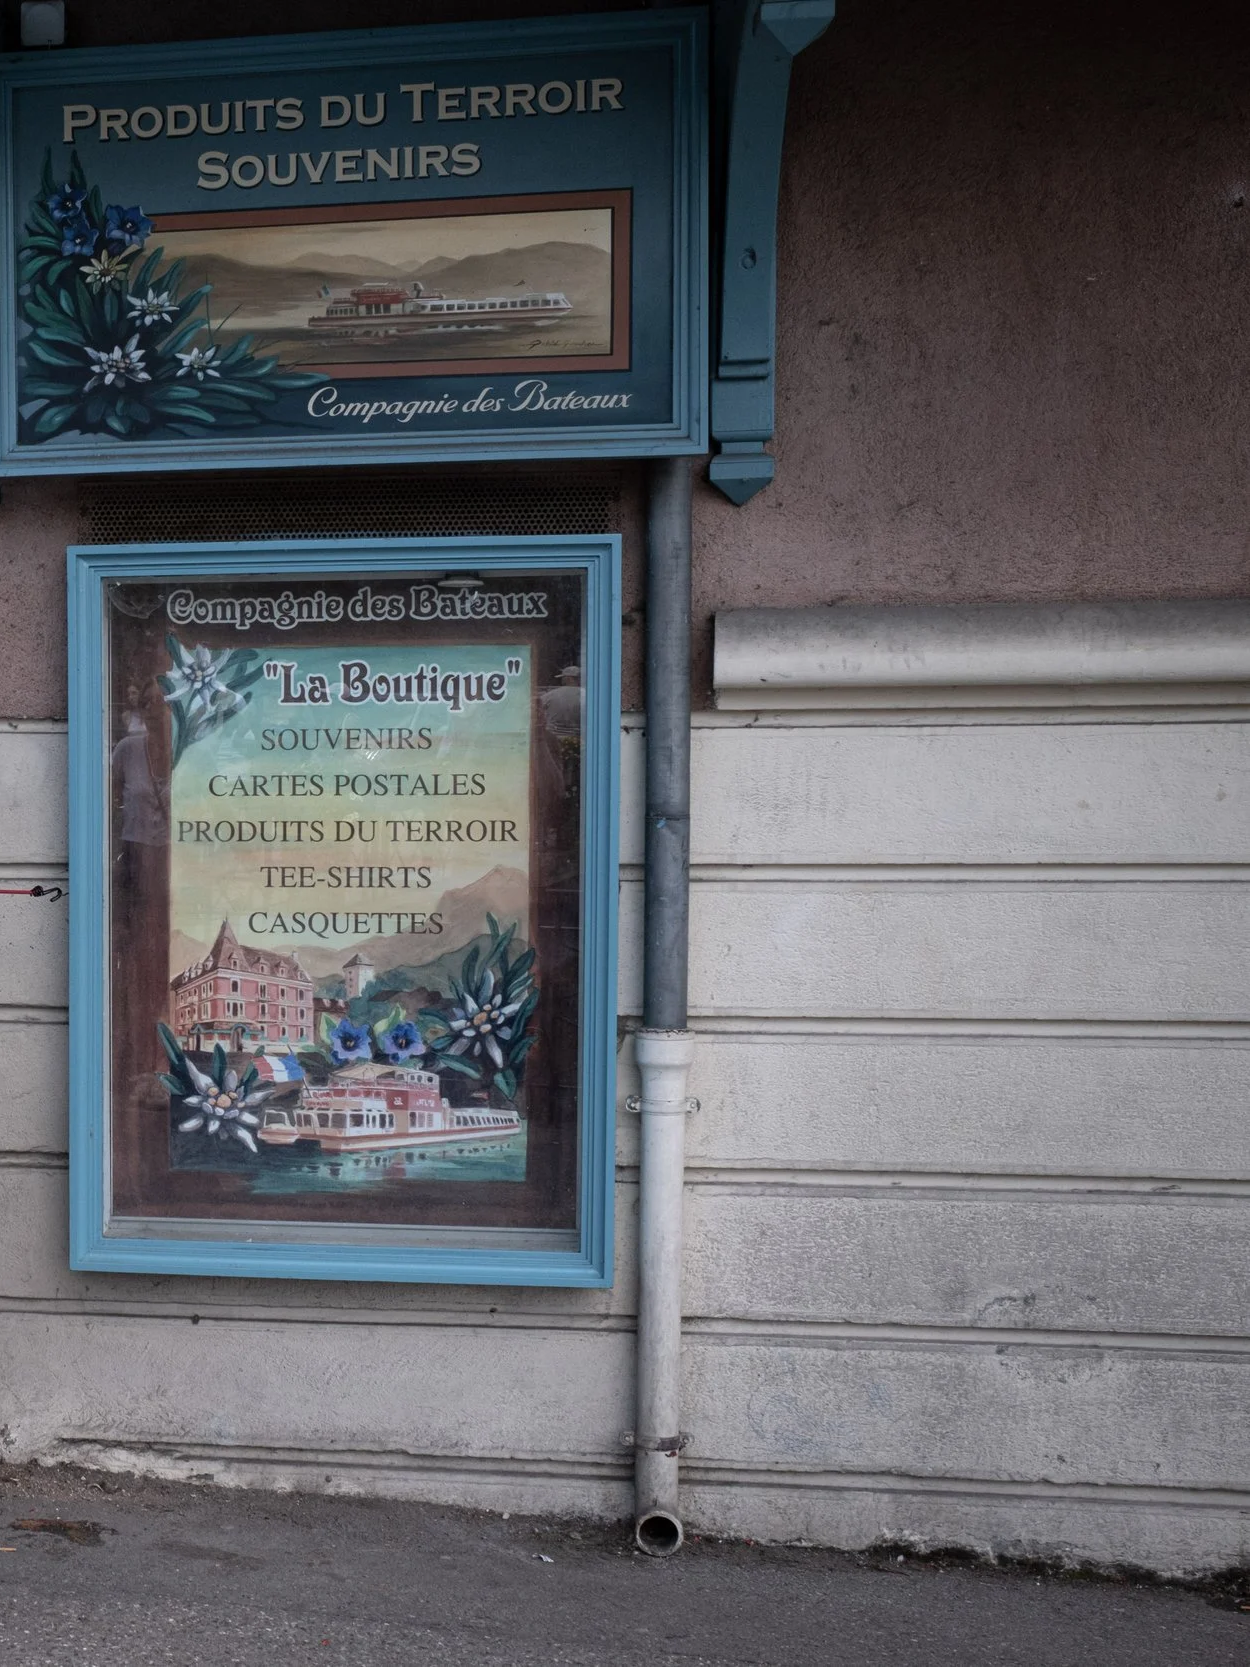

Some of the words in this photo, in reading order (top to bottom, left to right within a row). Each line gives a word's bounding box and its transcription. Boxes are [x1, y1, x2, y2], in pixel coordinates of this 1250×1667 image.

[62, 98, 304, 143] PRODUITS
[320, 91, 387, 129] DU
[400, 77, 625, 123] TERROIR
[197, 142, 482, 190] SOUVENIRS
[307, 386, 458, 424] Compagnie
[462, 386, 505, 414] des
[509, 379, 632, 413] Bateaux
[167, 589, 342, 630] Compagnie
[349, 588, 404, 622] des
[410, 585, 548, 620] Bateaux
[263, 661, 330, 705] "La
[340, 658, 522, 711] Boutique"
[261, 728, 432, 751] SOUVENIRS
[208, 774, 324, 798] CARTES
[334, 773, 486, 797] POSTALES
[177, 820, 324, 844] PRODUITS
[334, 820, 377, 844] DU
[386, 819, 519, 843] TERROIR
[260, 866, 432, 890] TEE-SHIRTS
[248, 912, 443, 938] CASQUETTES
